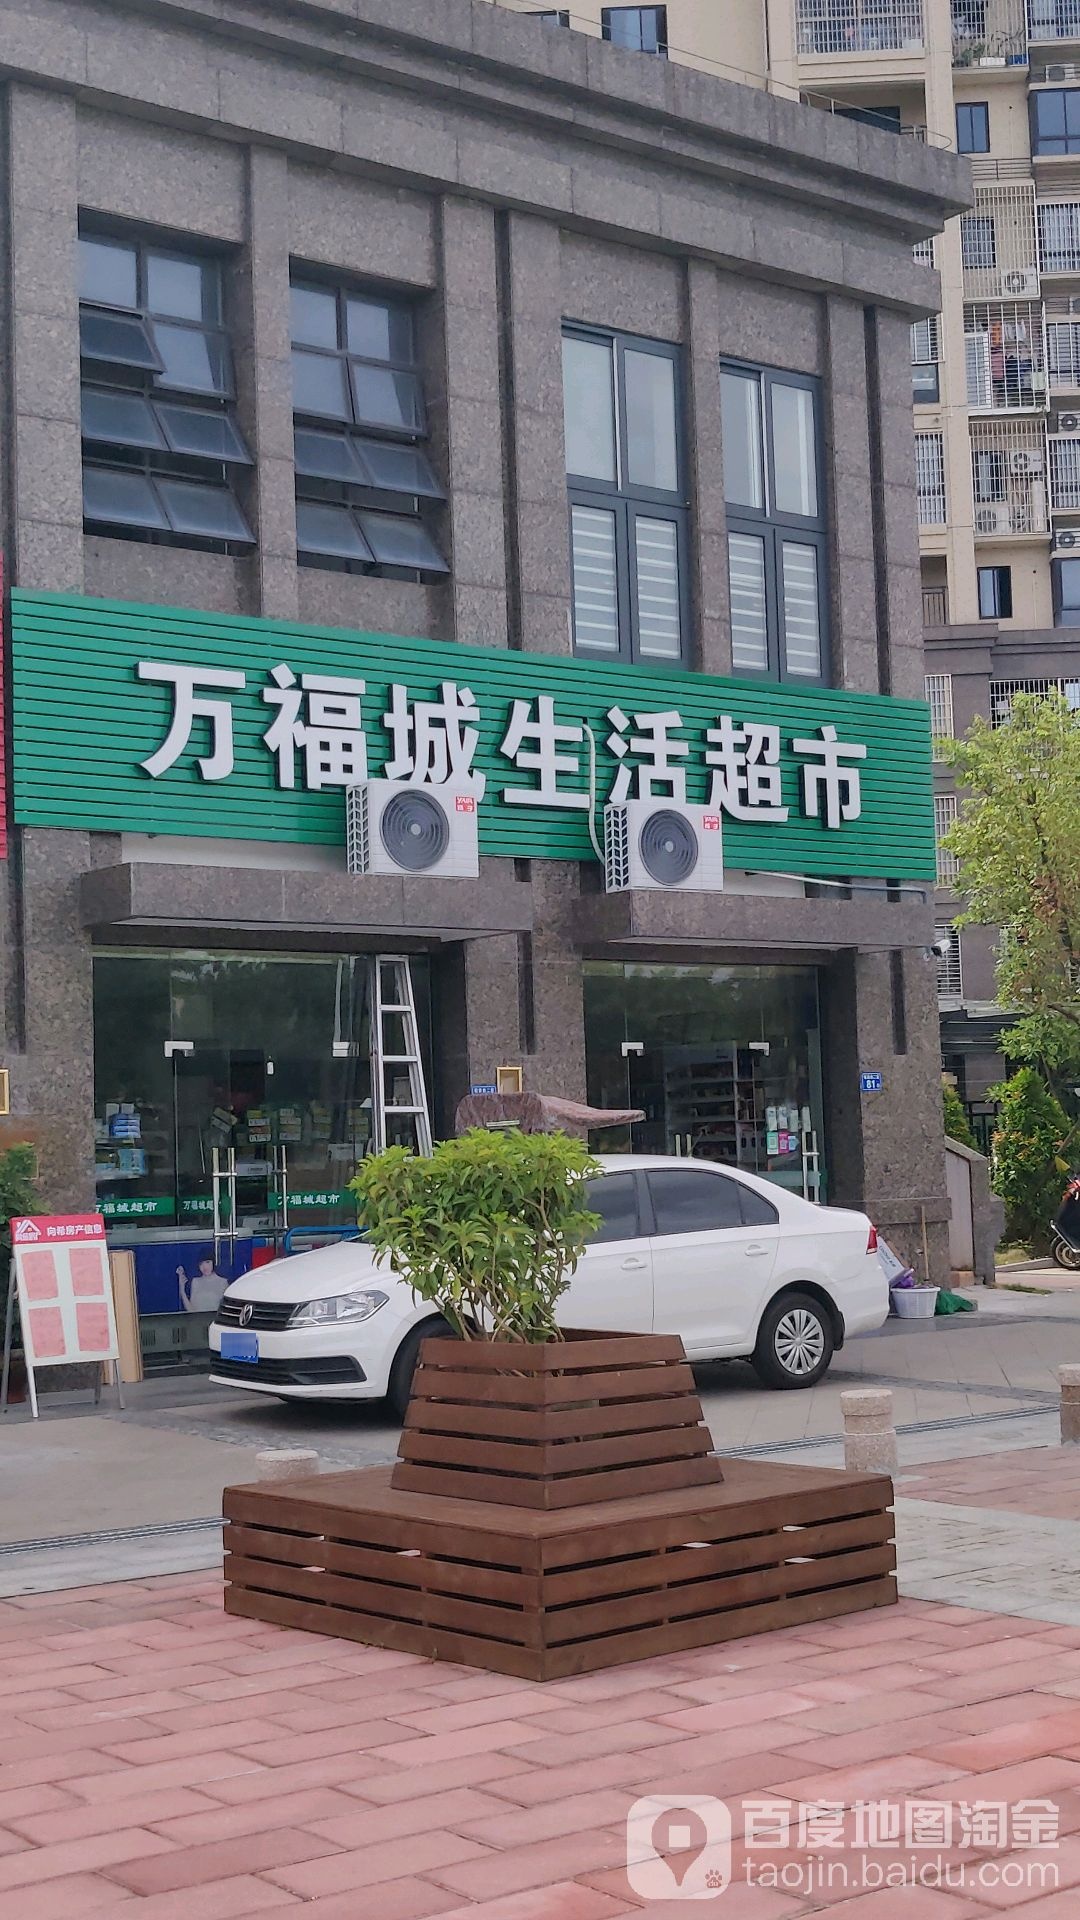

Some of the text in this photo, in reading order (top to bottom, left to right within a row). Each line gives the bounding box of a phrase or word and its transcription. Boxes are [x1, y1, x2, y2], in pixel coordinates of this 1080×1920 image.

[134, 660, 868, 829] 万福城生活超市
[183, 1200, 222, 1211] 万福城超
